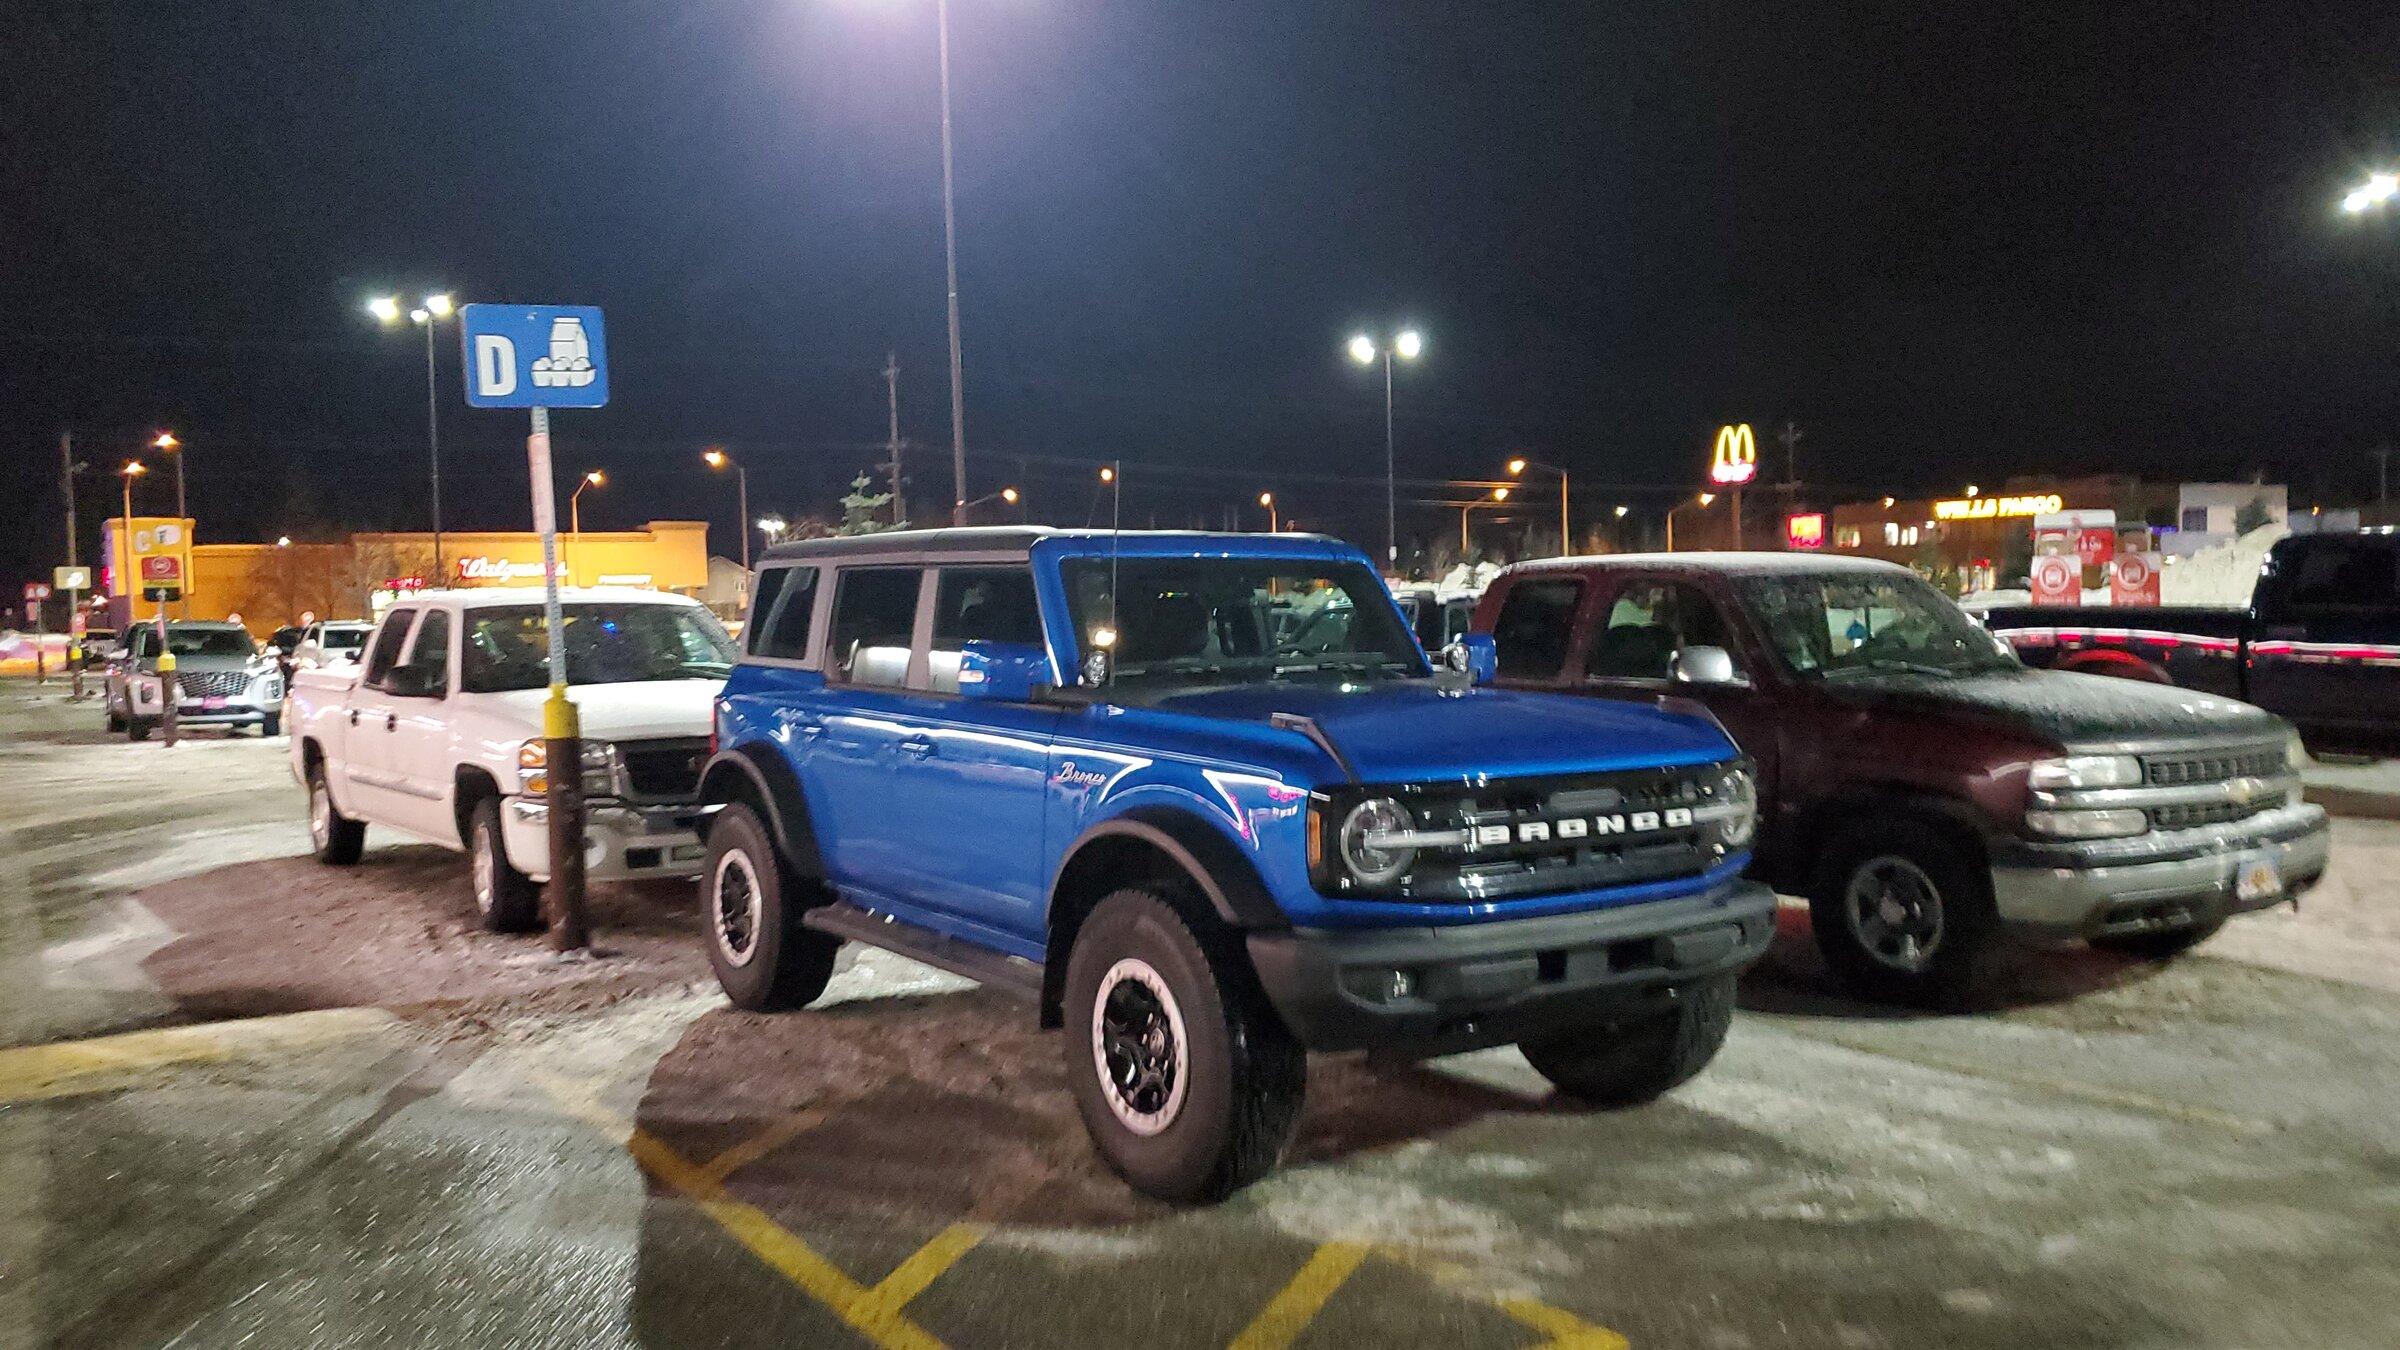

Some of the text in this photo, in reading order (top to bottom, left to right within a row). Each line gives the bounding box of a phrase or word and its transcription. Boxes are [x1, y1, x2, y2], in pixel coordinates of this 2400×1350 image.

[475, 335, 517, 396] D
[1998, 495, 2062, 516] FARGO
[1059, 761, 1106, 785] Bronco
[1478, 808, 1692, 844] BRONCO
